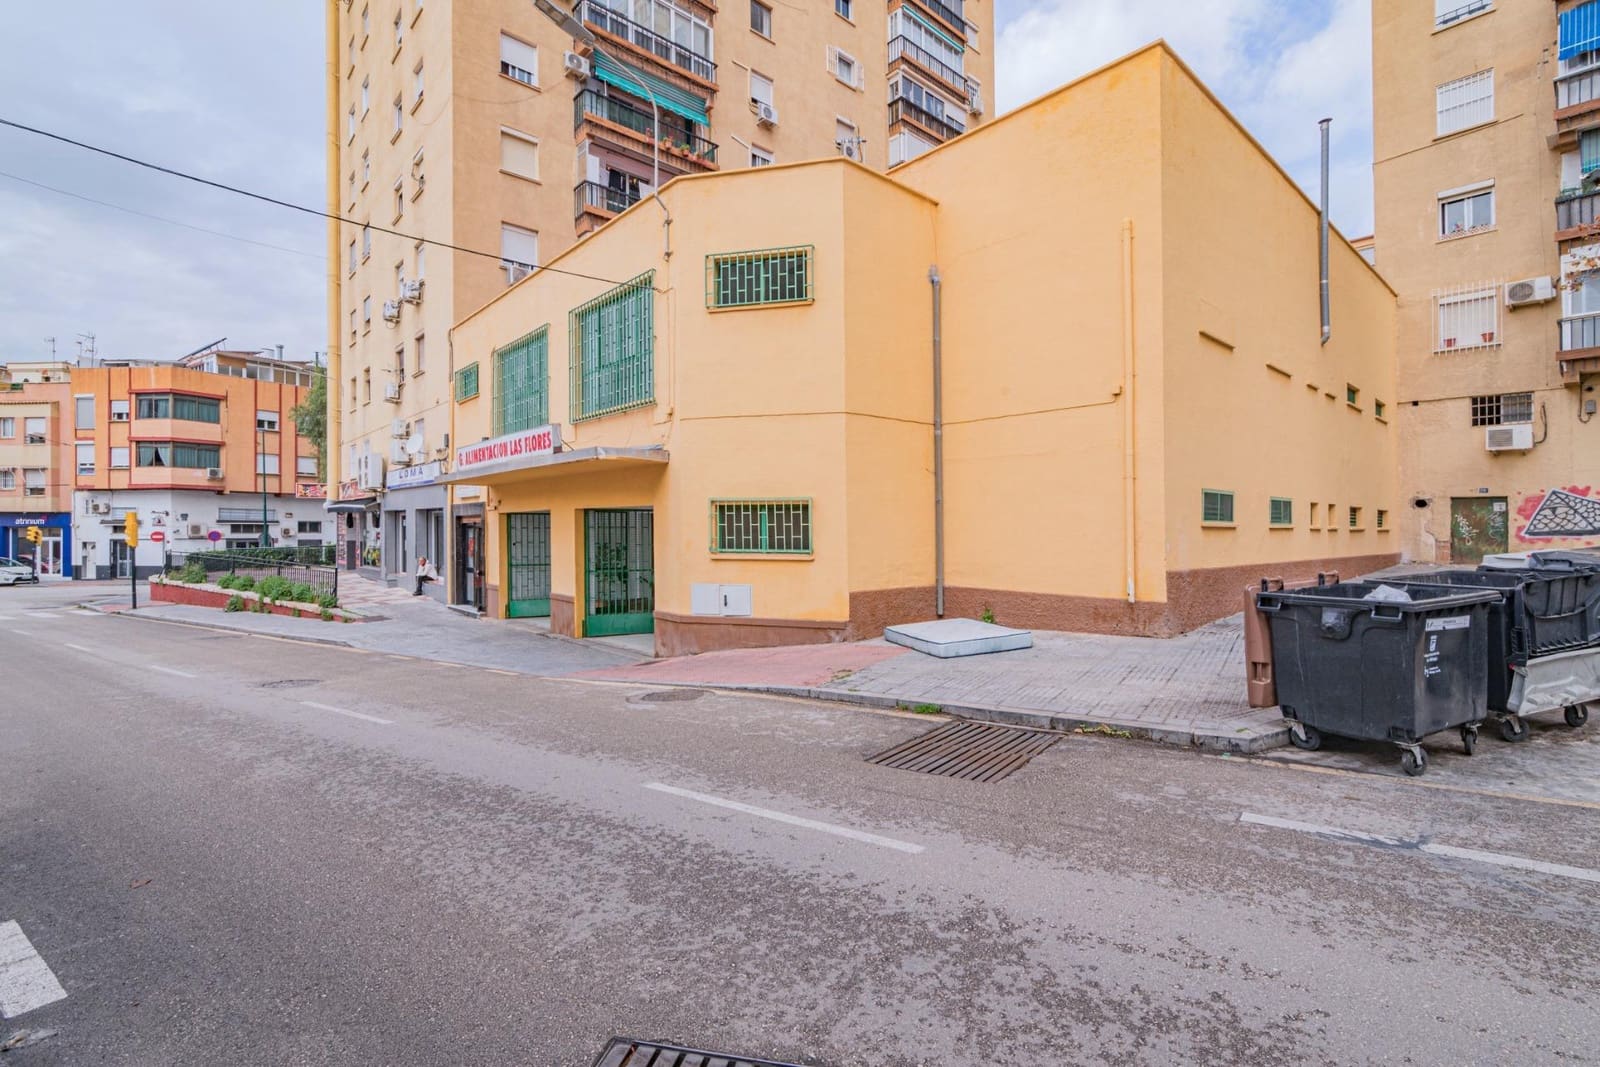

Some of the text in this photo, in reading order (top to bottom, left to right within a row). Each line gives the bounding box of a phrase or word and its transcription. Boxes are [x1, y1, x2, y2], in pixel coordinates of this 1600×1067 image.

[465, 441, 508, 465] ALIMENTACION
[510, 438, 522, 456] LAS
[525, 431, 552, 453] FLORES
